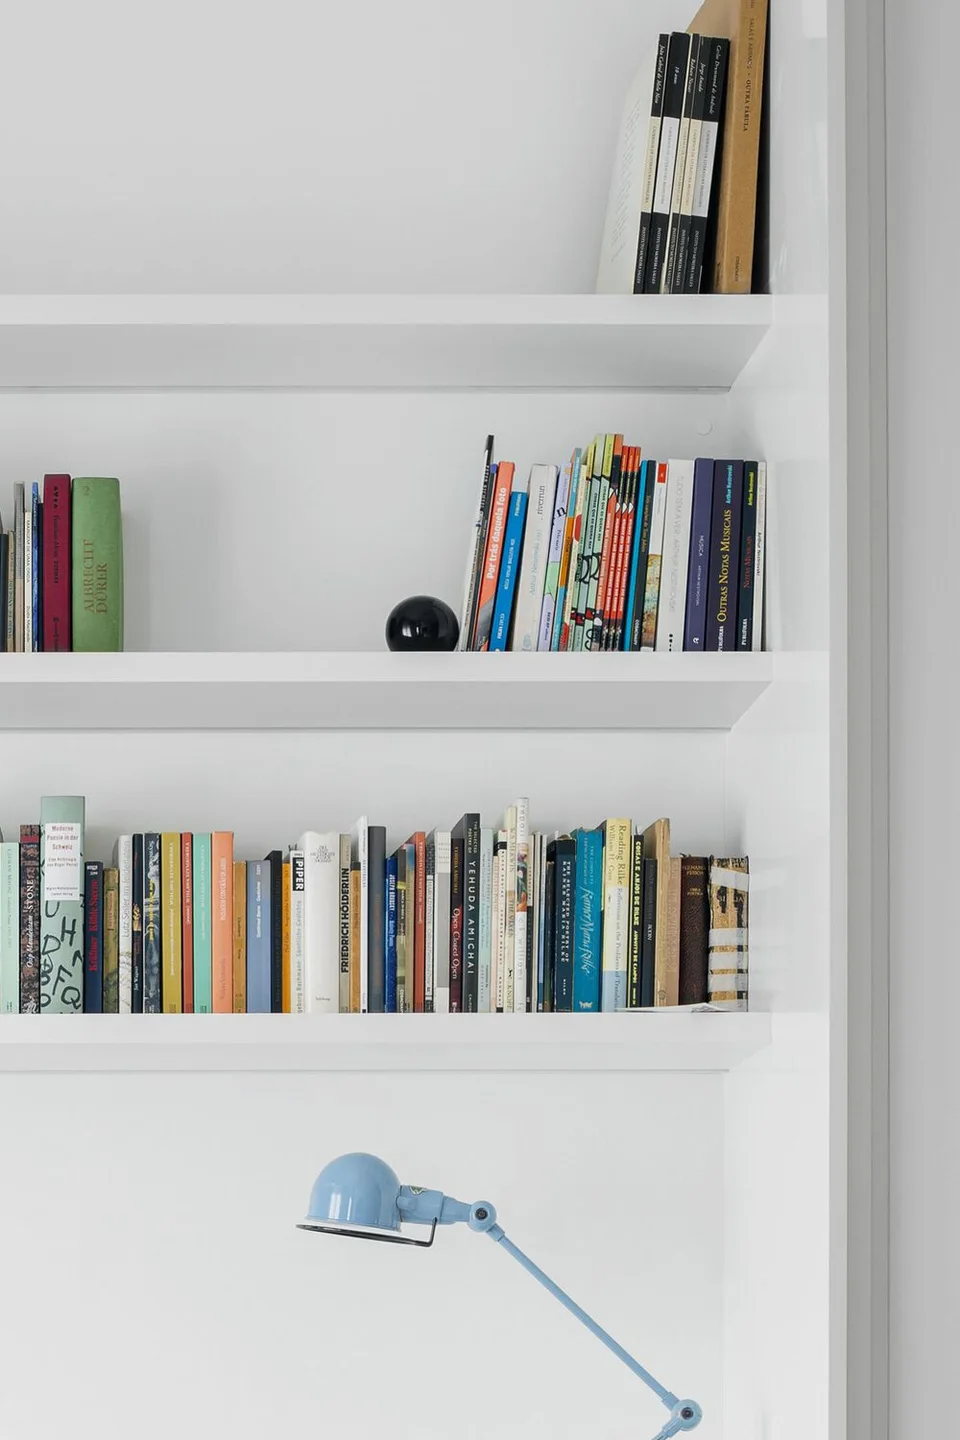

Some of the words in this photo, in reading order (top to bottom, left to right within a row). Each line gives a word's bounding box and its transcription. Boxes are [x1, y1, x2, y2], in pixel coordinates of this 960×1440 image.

[712, 61, 720, 88] Drummond
[84, 485, 90, 496] 2
[497, 488, 506, 506] foto
[676, 476, 684, 496] TUDO
[536, 485, 546, 514] riverrun
[493, 508, 505, 542] daquela
[488, 544, 500, 561] trás
[531, 542, 541, 573] Nestrovski
[672, 538, 680, 566] ARTHUR
[83, 539, 95, 613] ALBRECHT
[94, 563, 108, 613] DÜRER
[487, 563, 496, 579] Por
[529, 575, 538, 595] Arthur
[669, 570, 678, 612] NESTROVSKI
[616, 825, 626, 860] Reading
[617, 863, 625, 885] Rilke
[88, 879, 98, 906] Sterne
[123, 886, 130, 896] im
[340, 869, 349, 921] HÖLDERLIN
[579, 887, 594, 919] Rainer
[634, 896, 640, 905] DE
[88, 907, 98, 932] Kühle
[122, 899, 130, 919] Seiler
[451, 908, 460, 929] Open
[452, 931, 460, 956] Closed
[579, 919, 594, 947] Maria
[341, 923, 349, 974] FRIEDRICH
[579, 947, 596, 975] Rilke
[451, 958, 460, 979] Open
